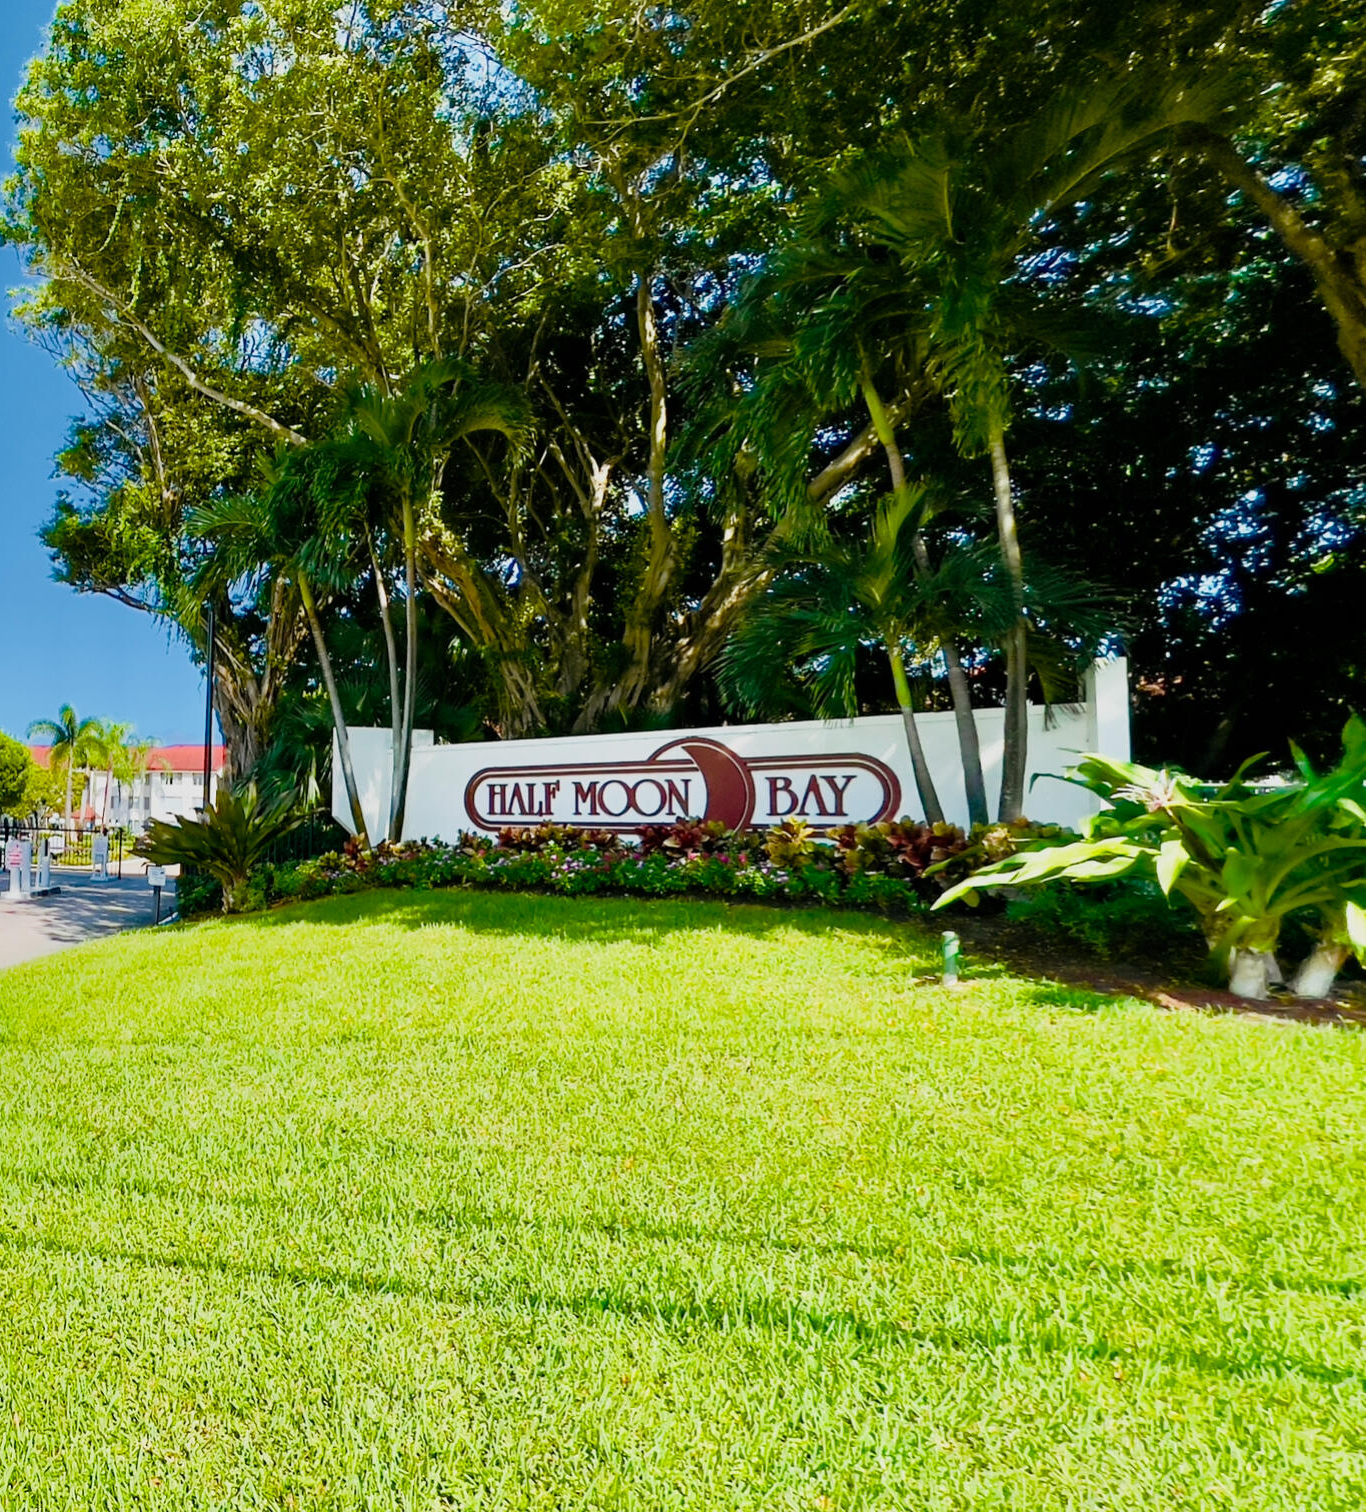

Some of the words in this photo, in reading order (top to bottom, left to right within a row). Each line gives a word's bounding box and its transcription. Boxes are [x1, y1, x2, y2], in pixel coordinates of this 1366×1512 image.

[487, 780, 560, 817] HALF
[572, 778, 692, 818] MOON
[764, 774, 858, 817] BAY
